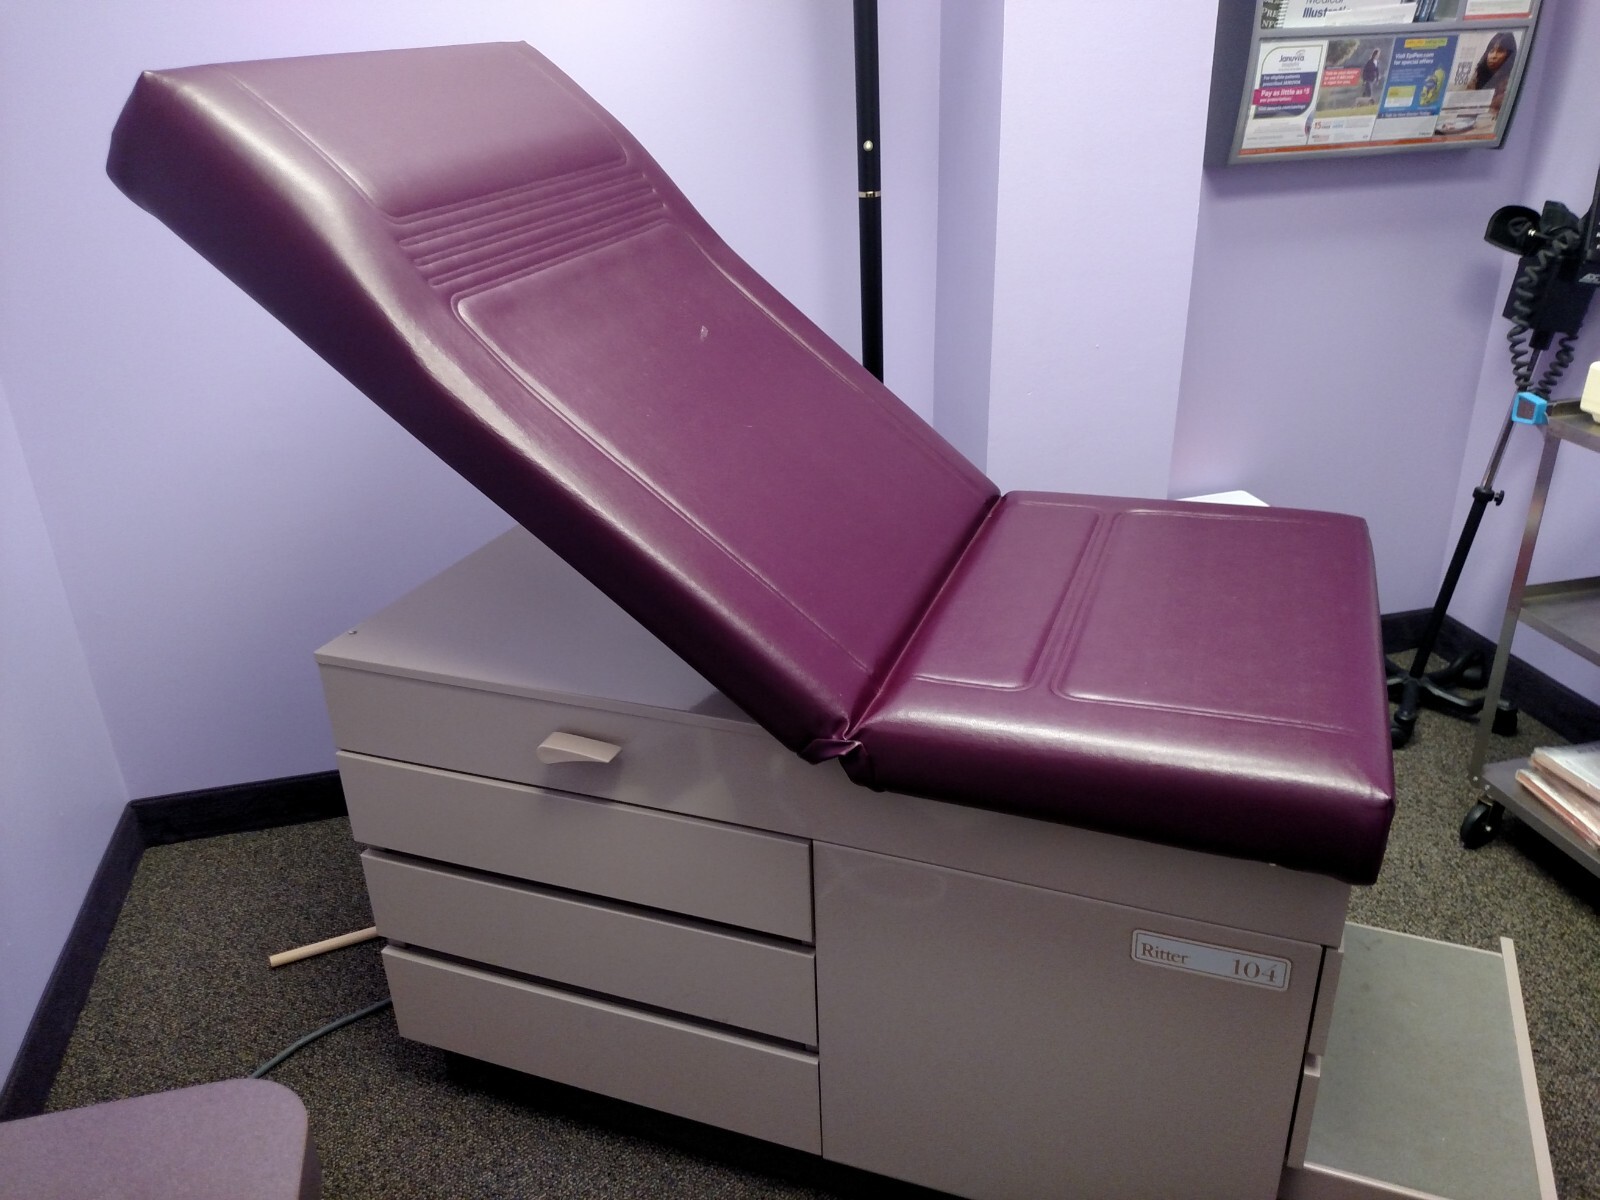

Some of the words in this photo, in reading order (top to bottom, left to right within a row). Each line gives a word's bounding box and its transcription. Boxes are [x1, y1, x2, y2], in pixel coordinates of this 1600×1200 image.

[1260, 89, 1272, 97] Pay
[1141, 942, 1189, 964] Ritter
[1232, 959, 1277, 983] 104
